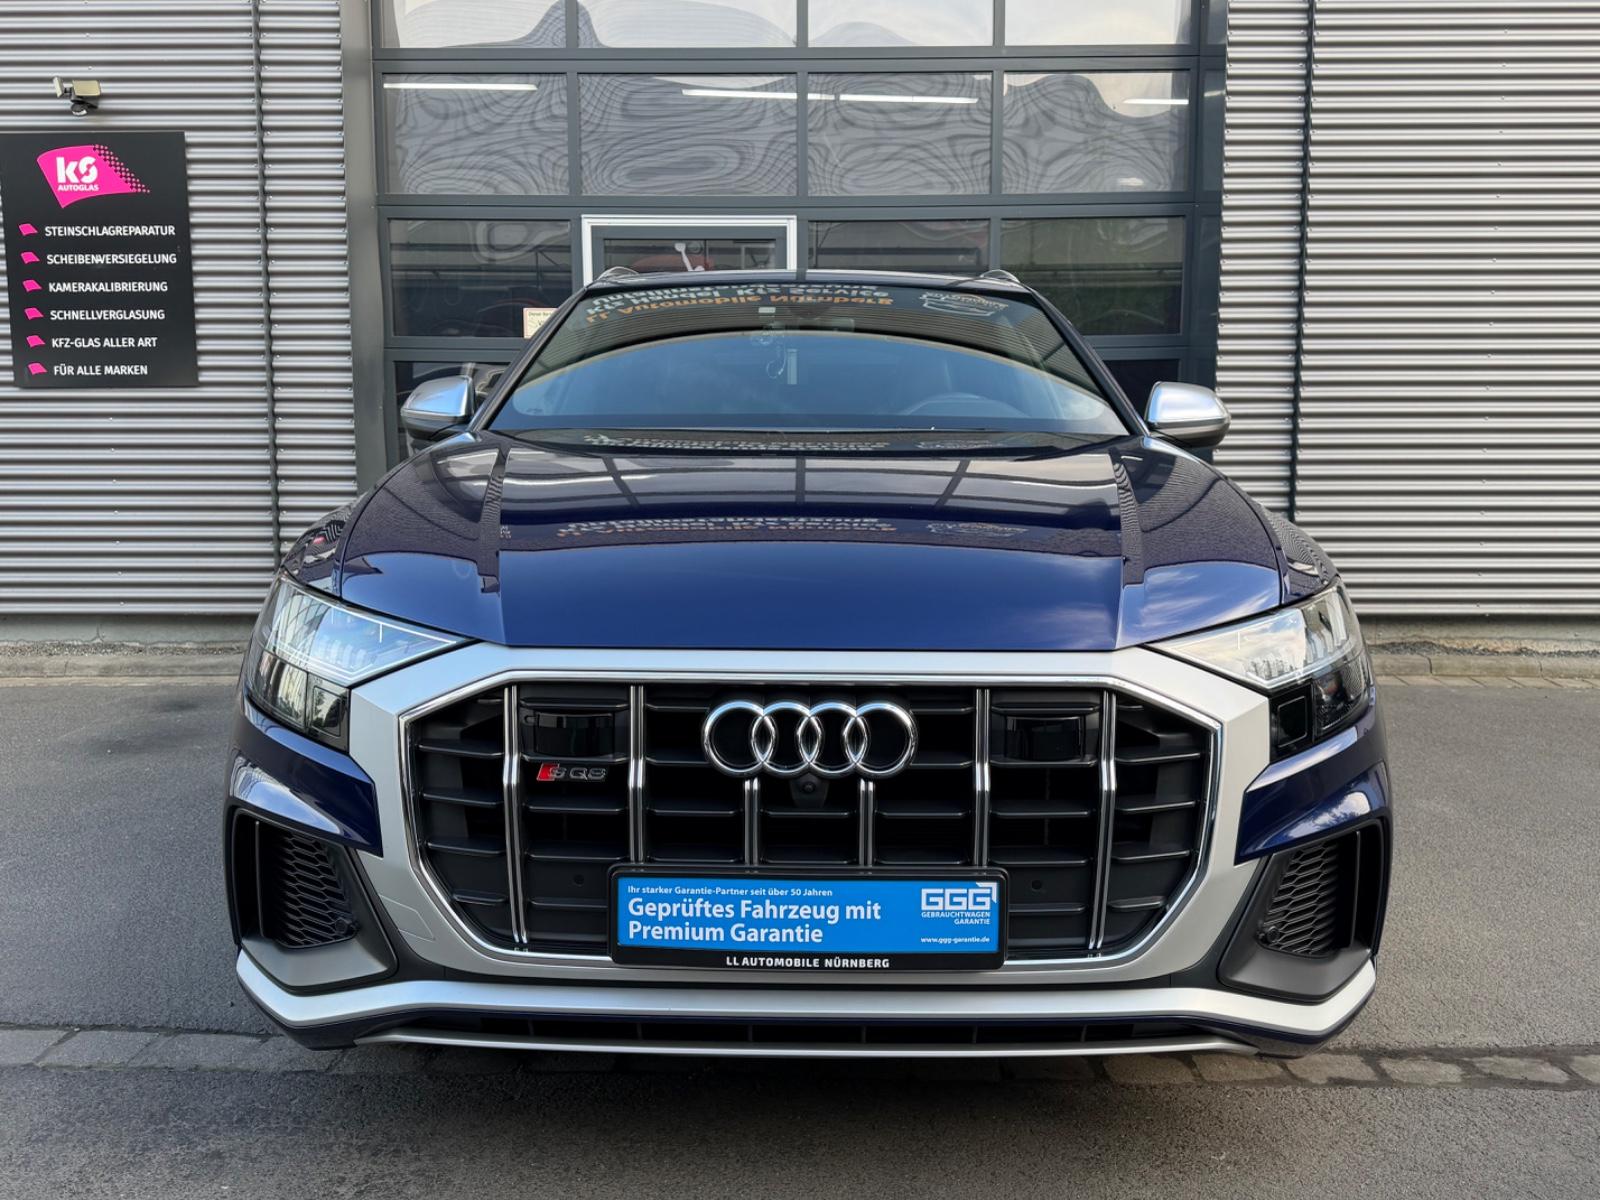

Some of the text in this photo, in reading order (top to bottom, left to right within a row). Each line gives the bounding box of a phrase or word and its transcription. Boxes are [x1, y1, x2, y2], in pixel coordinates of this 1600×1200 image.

[57, 184, 99, 192] AUTOGLAS
[44, 225, 176, 237] STEINSCHLAGREPARATUR
[46, 253, 177, 265] SCHEIBENVERSIEGELUNG
[48, 281, 168, 293] KAMERAKALIBRIERUNG
[49, 309, 166, 321] SCHNELLVERGLASUNG
[51, 336, 158, 349] KFZ-GLAS ALLER ART
[53, 363, 148, 376] FÜR ALLE MARKEN
[628, 886, 833, 898] Ihr starker Garantie-Partner seit über 50 Jahren
[921, 888, 991, 910] GGG
[628, 897, 881, 925] Geprüftes Fahrzeug mit
[628, 921, 823, 943] Premium Garantie
[920, 936, 991, 944] www.ggg-garantie.de
[726, 955, 890, 968] LL AUTOMOBILE NÜRNBERG
